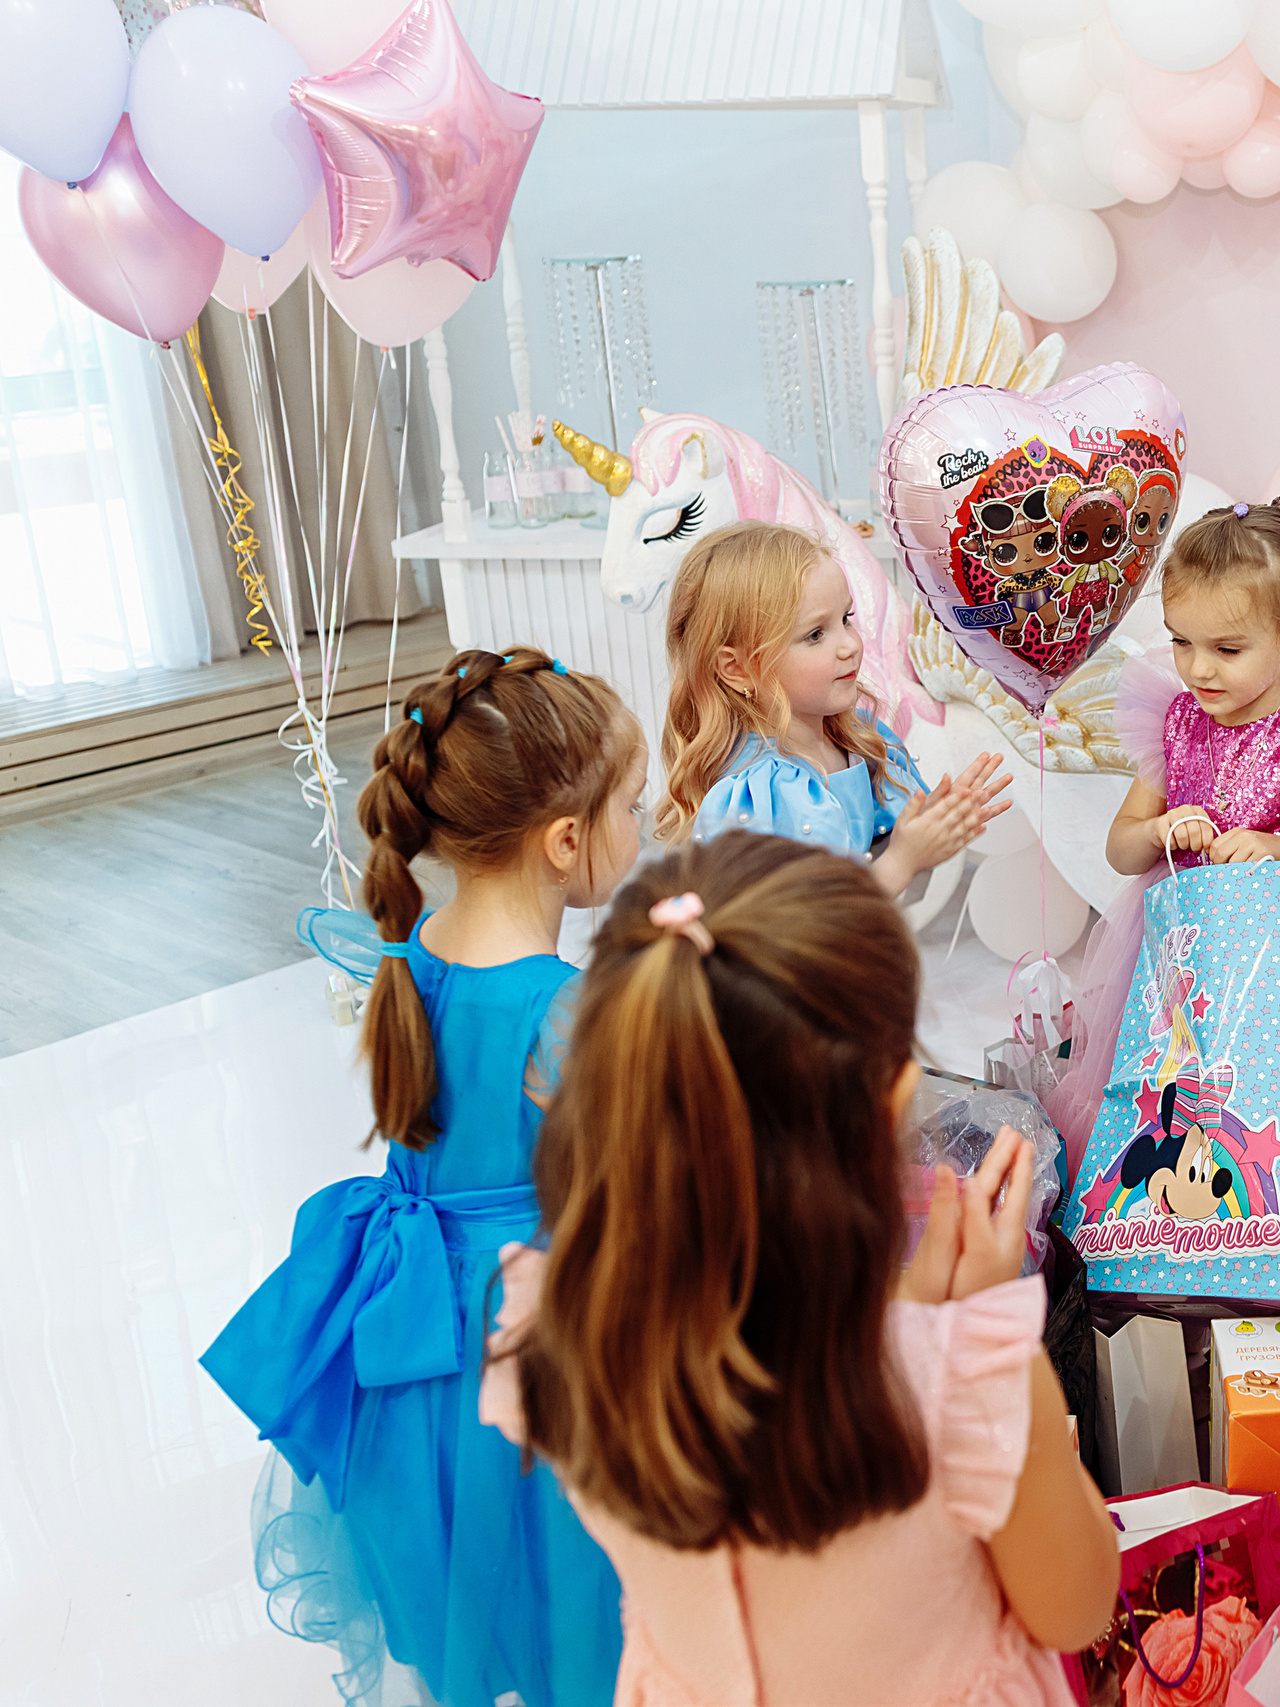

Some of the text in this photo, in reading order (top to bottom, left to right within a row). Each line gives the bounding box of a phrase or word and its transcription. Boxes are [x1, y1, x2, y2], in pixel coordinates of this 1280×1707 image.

[1078, 441, 1117, 453] SURPRISE!
[939, 448, 978, 472] Rock
[942, 472, 960, 487] the
[960, 605, 1010, 625] ROCK
